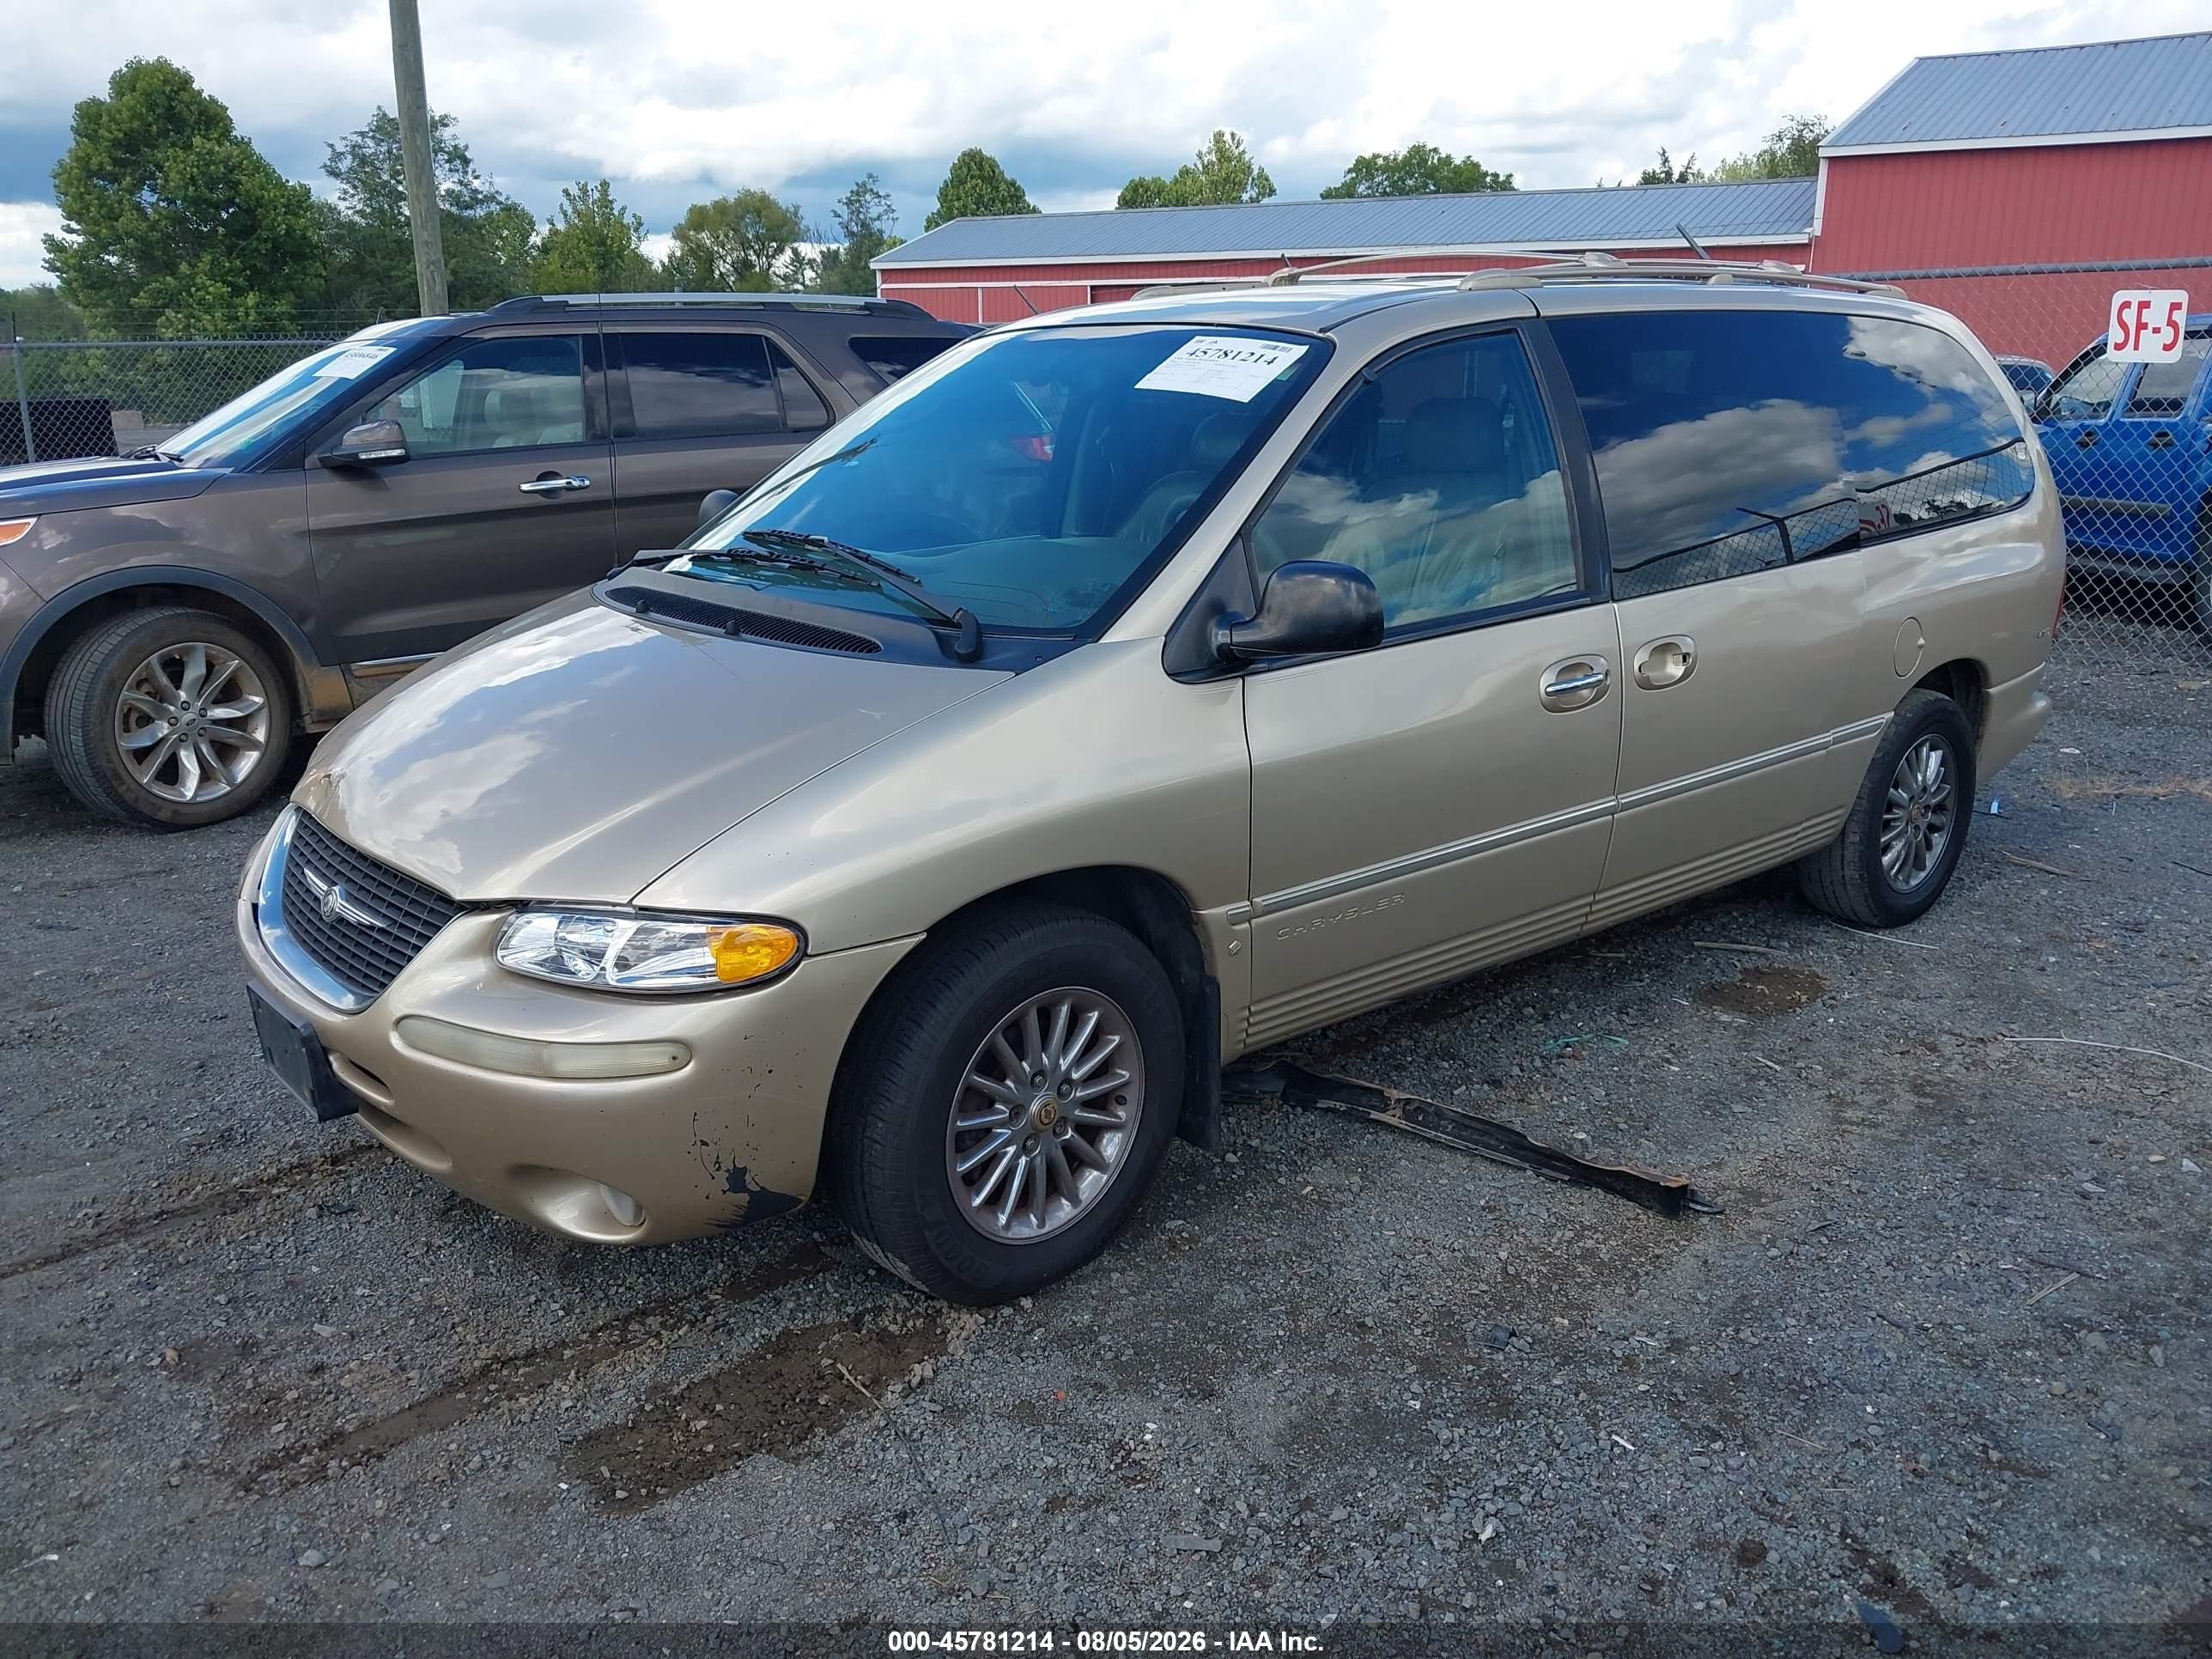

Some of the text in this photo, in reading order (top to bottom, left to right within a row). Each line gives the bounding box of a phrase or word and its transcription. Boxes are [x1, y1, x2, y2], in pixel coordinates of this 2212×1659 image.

[2113, 300, 2184, 352] SF-5
[1186, 346, 1280, 366] 45781214
[1277, 892, 1406, 940] CHRYSLER
